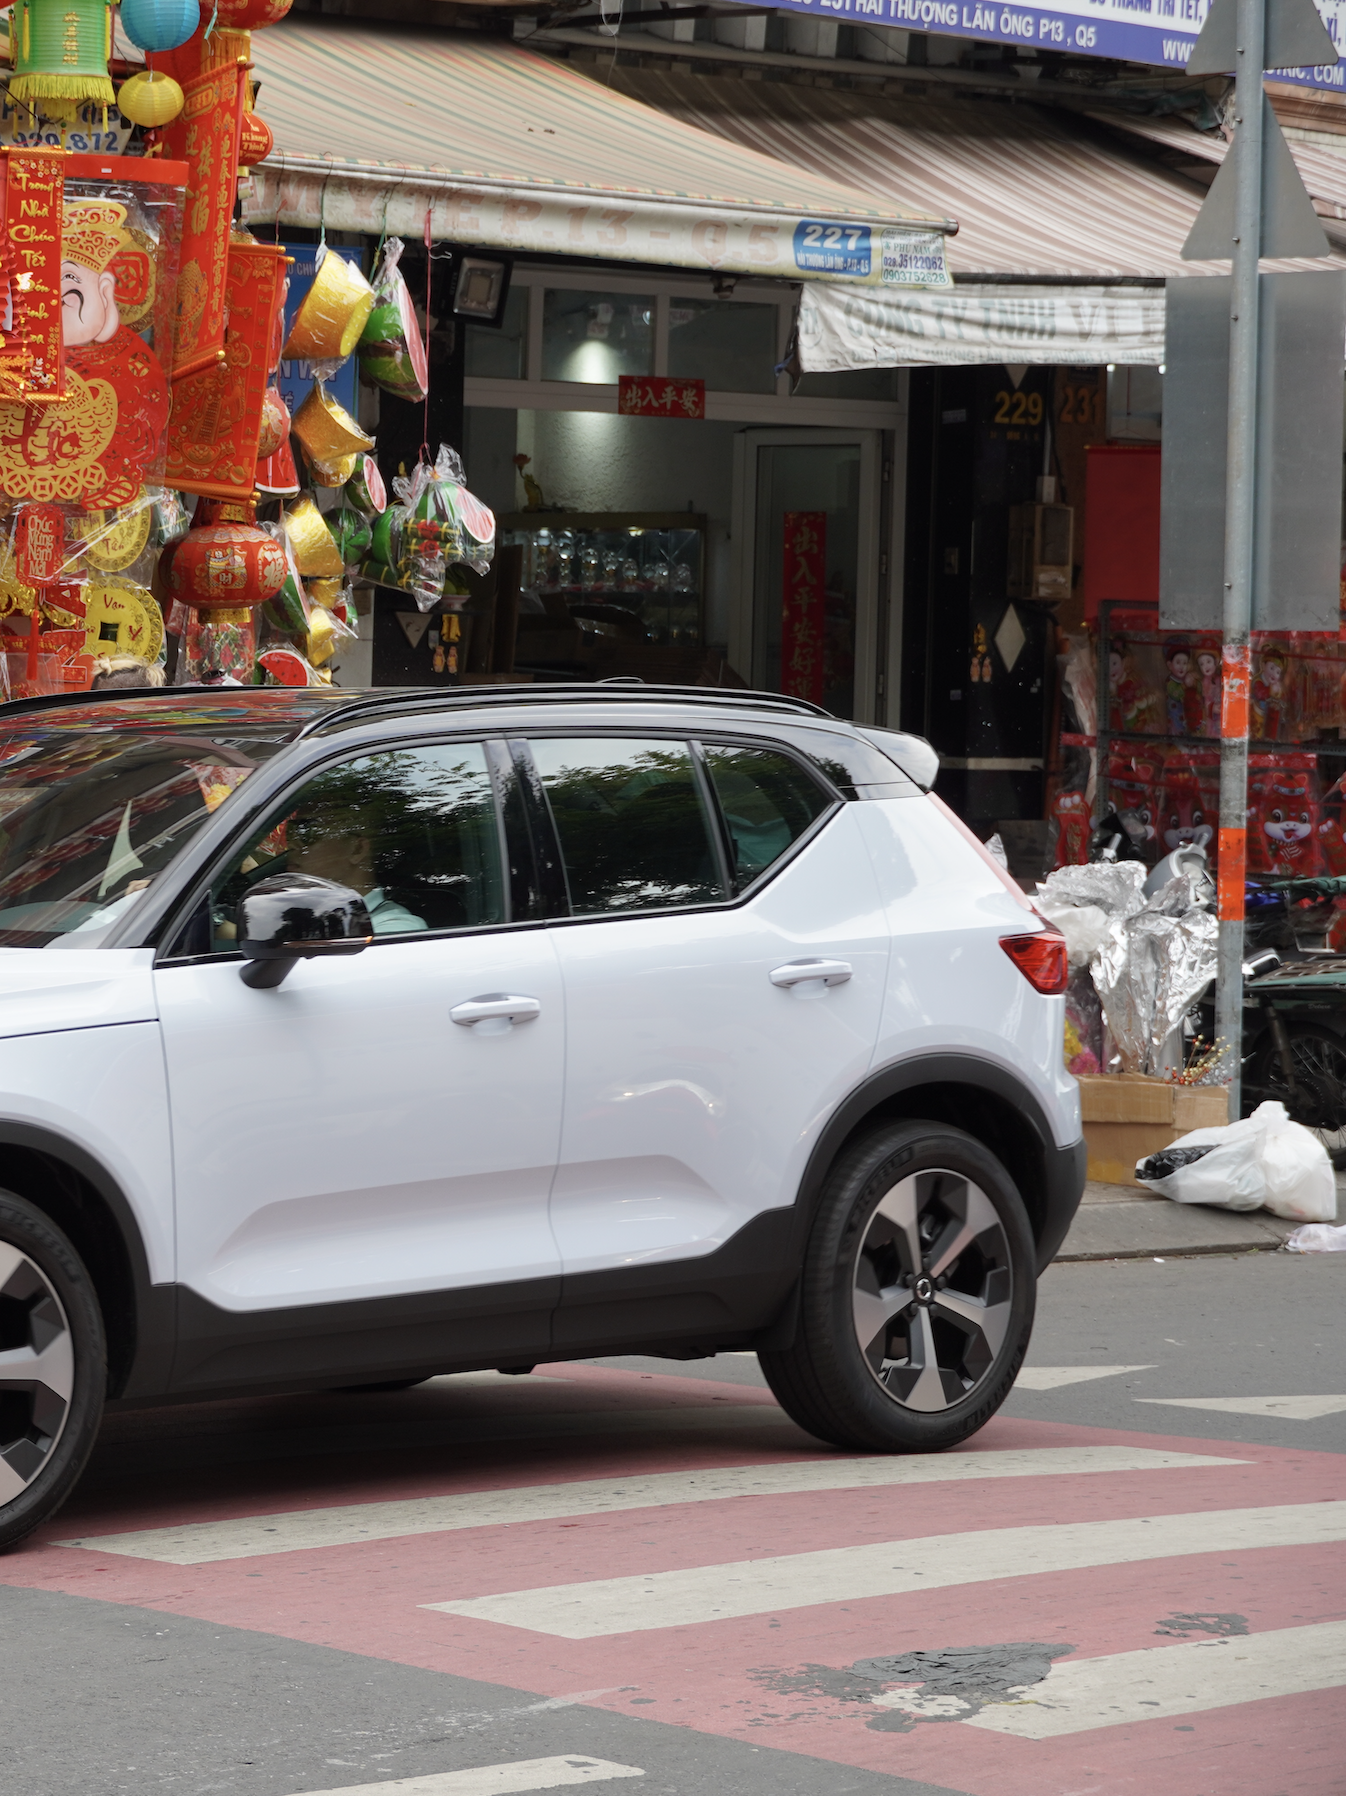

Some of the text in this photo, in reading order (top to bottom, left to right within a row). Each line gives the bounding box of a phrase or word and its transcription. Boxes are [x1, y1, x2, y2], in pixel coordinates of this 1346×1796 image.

[961, 8, 995, 32] LÃN
[1000, 8, 1034, 38] ÔNG
[1039, 21, 1063, 43] P13
[1075, 24, 1097, 48] Q5
[16, 173, 54, 207] Trong
[20, 199, 49, 219] Nhà
[9, 224, 56, 243] Chúc
[690, 218, 780, 267] Q.5
[802, 224, 863, 251] 227
[21, 250, 47, 269] Tết
[883, 268, 947, 283] 0903752628
[25, 302, 50, 320] inh
[930, 298, 969, 341] TY
[979, 299, 1055, 342] TNHH
[625, 384, 701, 418] 出入平安
[994, 390, 1043, 426] 229
[1059, 386, 1105, 426] 231
[27, 514, 54, 534] Chúc
